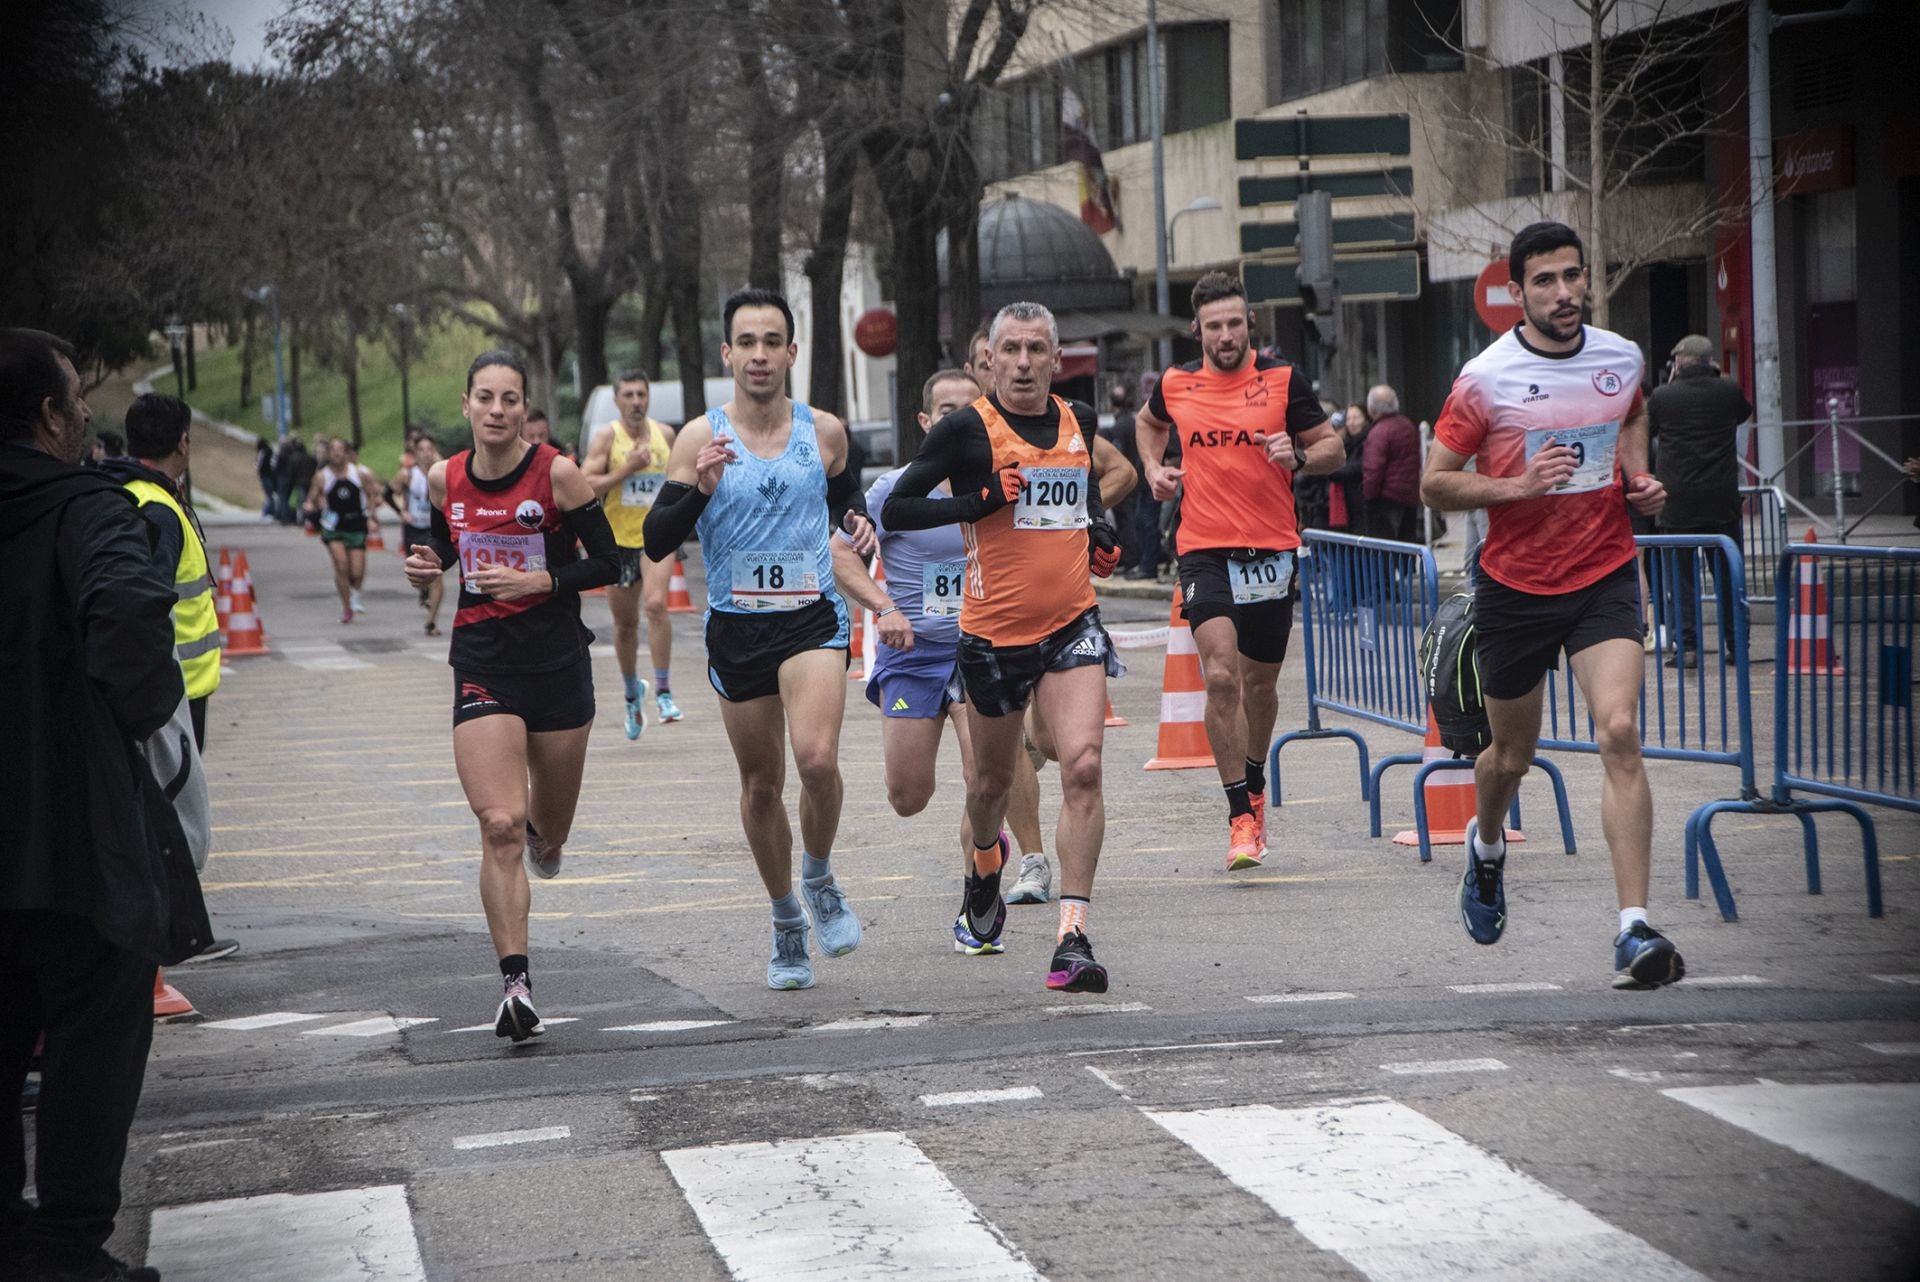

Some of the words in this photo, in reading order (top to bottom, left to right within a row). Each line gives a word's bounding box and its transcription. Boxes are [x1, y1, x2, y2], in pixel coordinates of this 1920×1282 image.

[1794, 149, 1834, 176] Santander
[1523, 393, 1549, 403] VIATOR
[1552, 441, 1585, 468] 9
[1024, 481, 1078, 506] 1200
[463, 547, 526, 573] 1952
[753, 565, 785, 589] 18
[1240, 564, 1277, 585] 110
[1072, 648, 1099, 657] adidas
